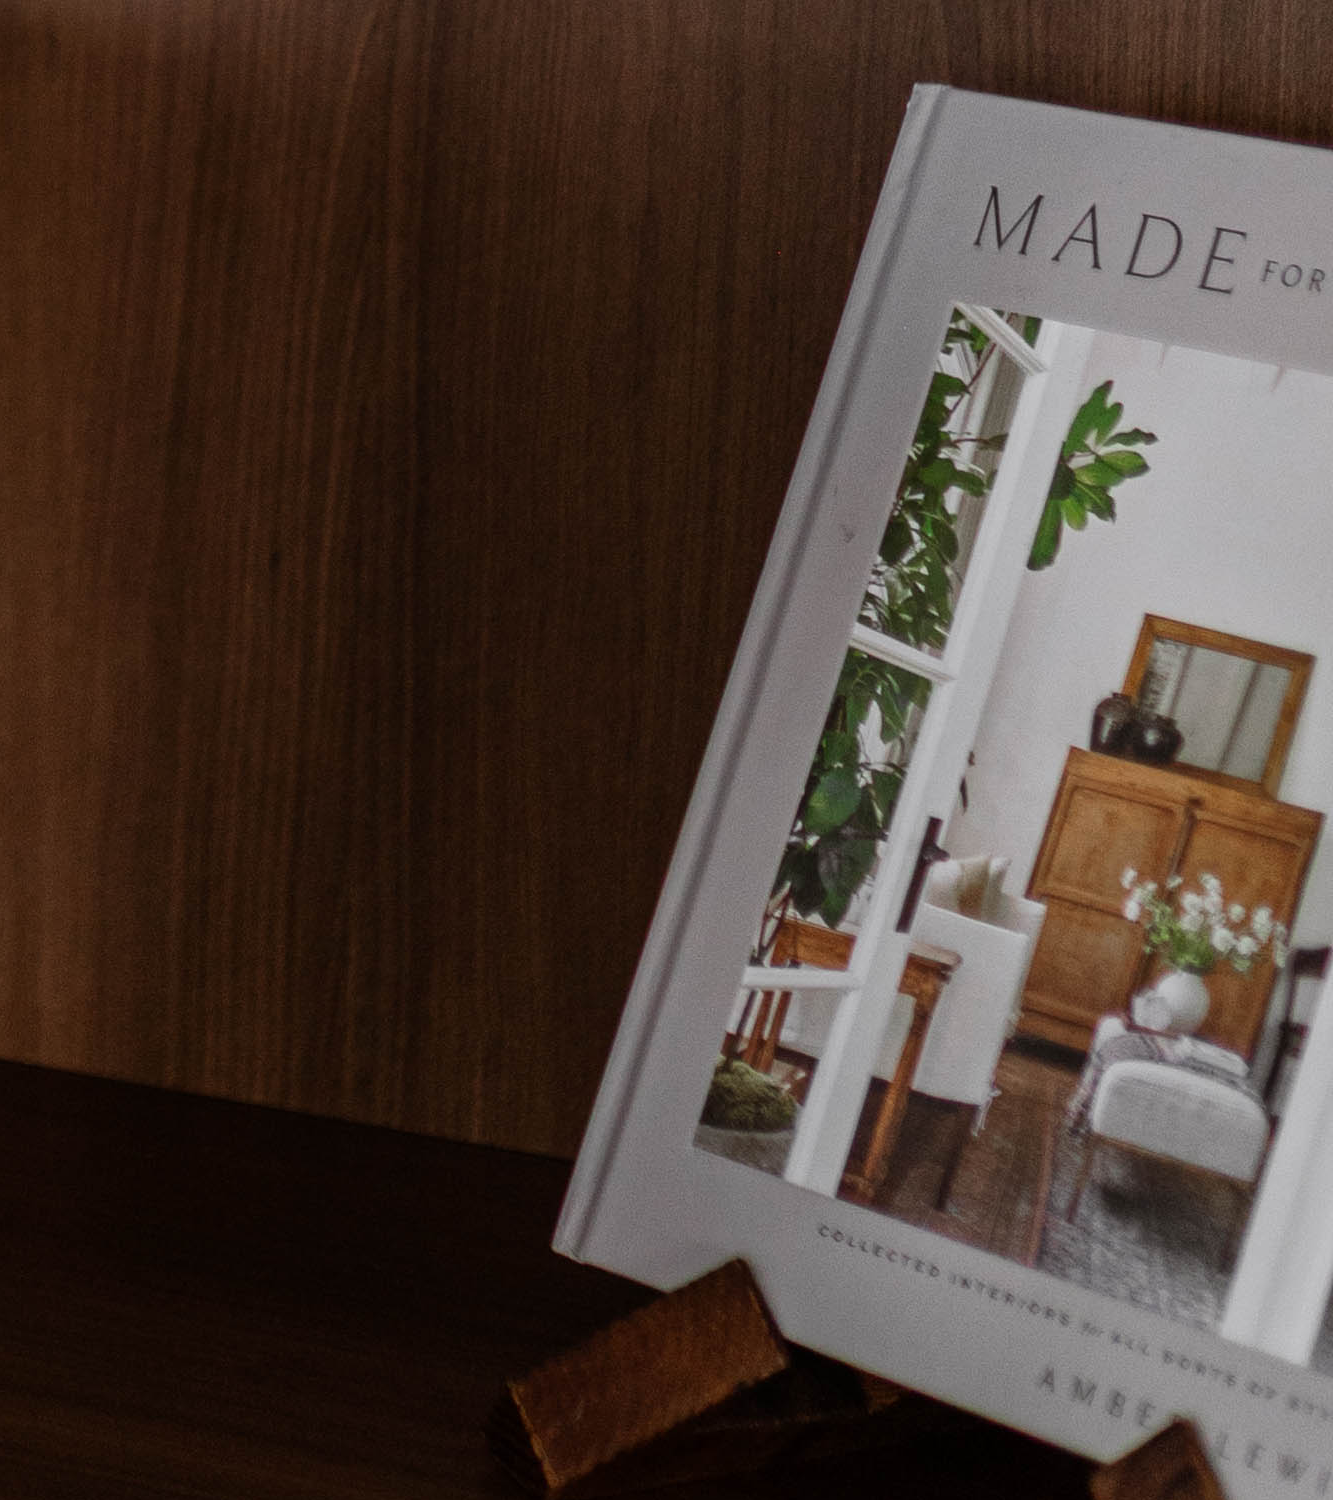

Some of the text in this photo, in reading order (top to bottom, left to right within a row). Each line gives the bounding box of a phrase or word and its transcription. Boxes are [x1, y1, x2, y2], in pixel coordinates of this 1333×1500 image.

[973, 185, 1326, 295] MADE FOR
[816, 1222, 941, 1278] COLLECTED
[947, 1271, 1071, 1328] INTERIORS
[1037, 1365, 1159, 1428] AMBE
